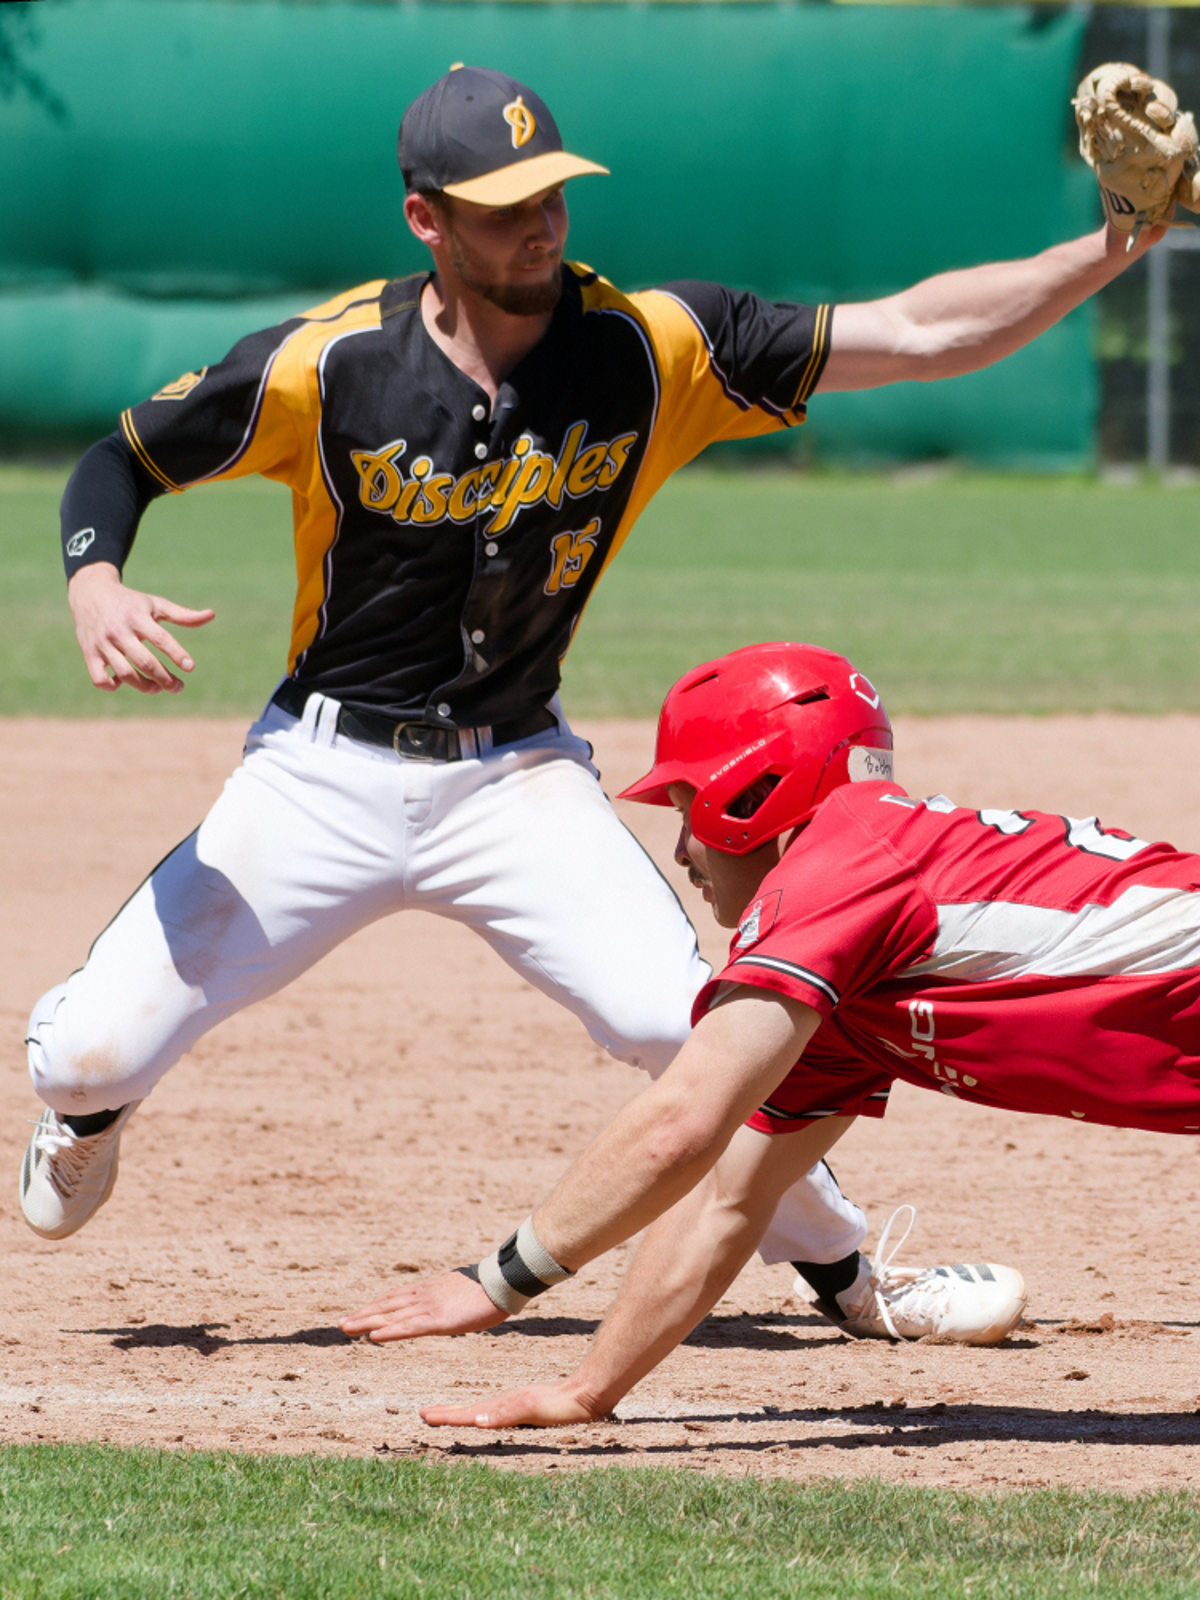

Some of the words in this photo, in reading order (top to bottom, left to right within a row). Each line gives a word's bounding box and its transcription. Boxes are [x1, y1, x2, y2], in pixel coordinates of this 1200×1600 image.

[503, 95, 536, 149] D
[351, 420, 637, 537] Disciples
[544, 517, 601, 595] 15
[709, 738, 766, 781] EVOSHIELD
